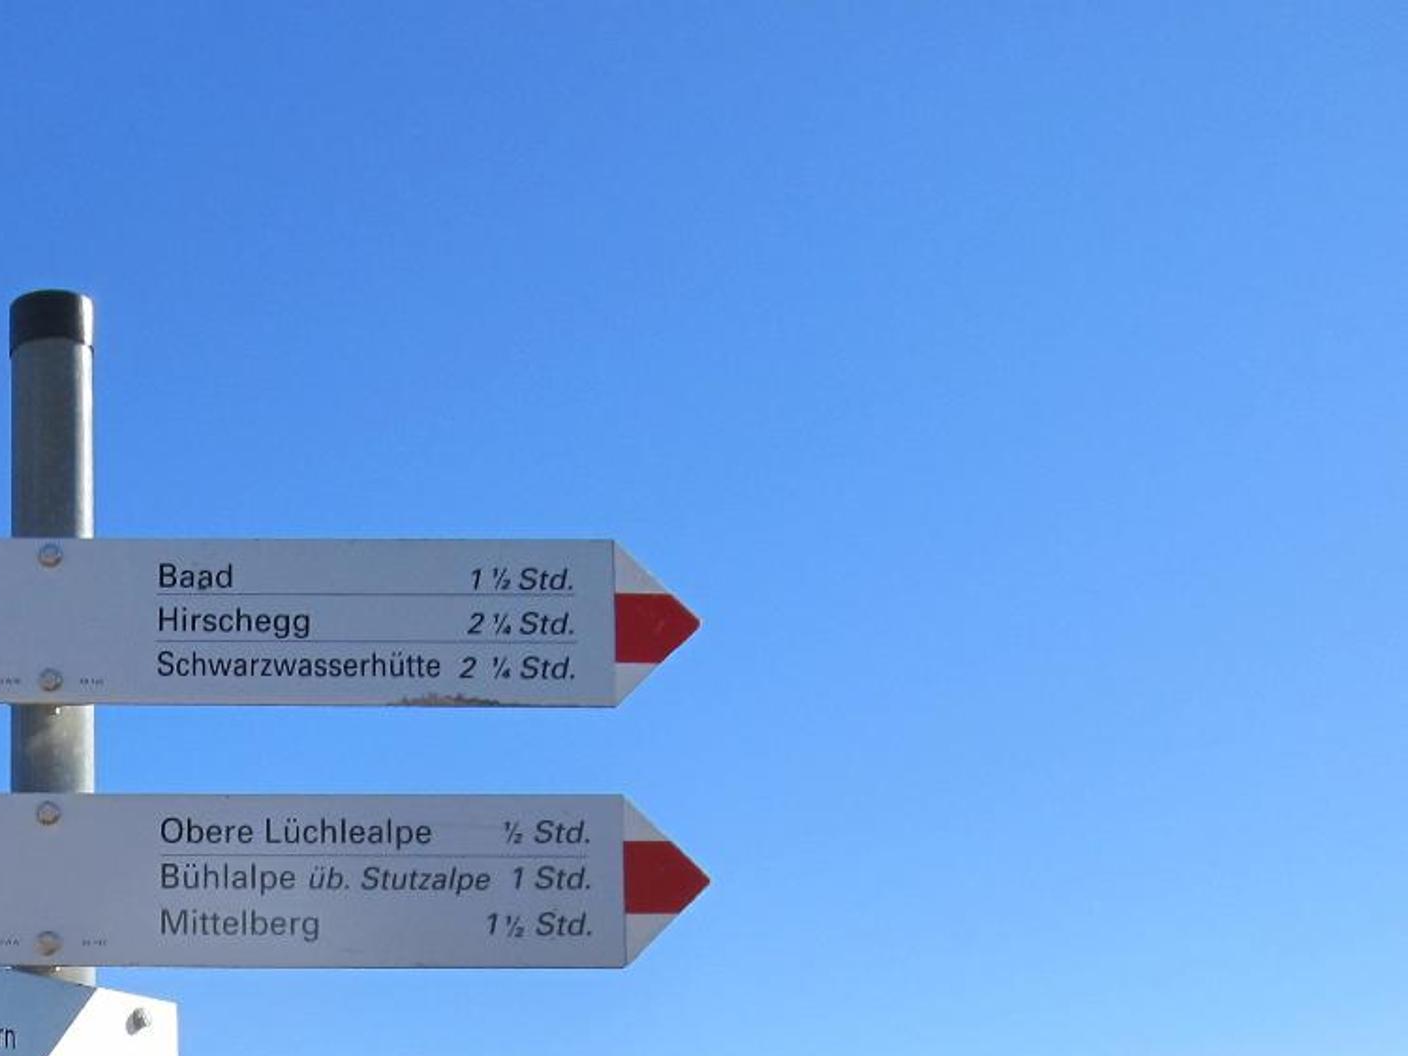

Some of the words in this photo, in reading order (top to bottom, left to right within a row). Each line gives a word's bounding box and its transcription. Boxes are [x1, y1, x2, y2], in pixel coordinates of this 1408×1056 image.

[158, 562, 233, 591] Baad
[518, 567, 574, 591] Std.
[158, 606, 311, 640] Hirschegg
[519, 611, 575, 636] Std.
[157, 650, 441, 678] Schwarzwasserhütte
[458, 656, 477, 679] 2
[519, 655, 575, 680] Std.
[160, 817, 254, 844] Obere
[265, 817, 432, 848] Lüchlealpe
[534, 819, 591, 844] Std.
[160, 862, 296, 893] Bühlalpe
[309, 865, 350, 890] üb.
[361, 866, 491, 895] Stutzalpe
[512, 866, 524, 890] 1
[534, 865, 591, 891] Std.
[160, 908, 320, 942] Mittelberg
[535, 911, 593, 937] Std.
